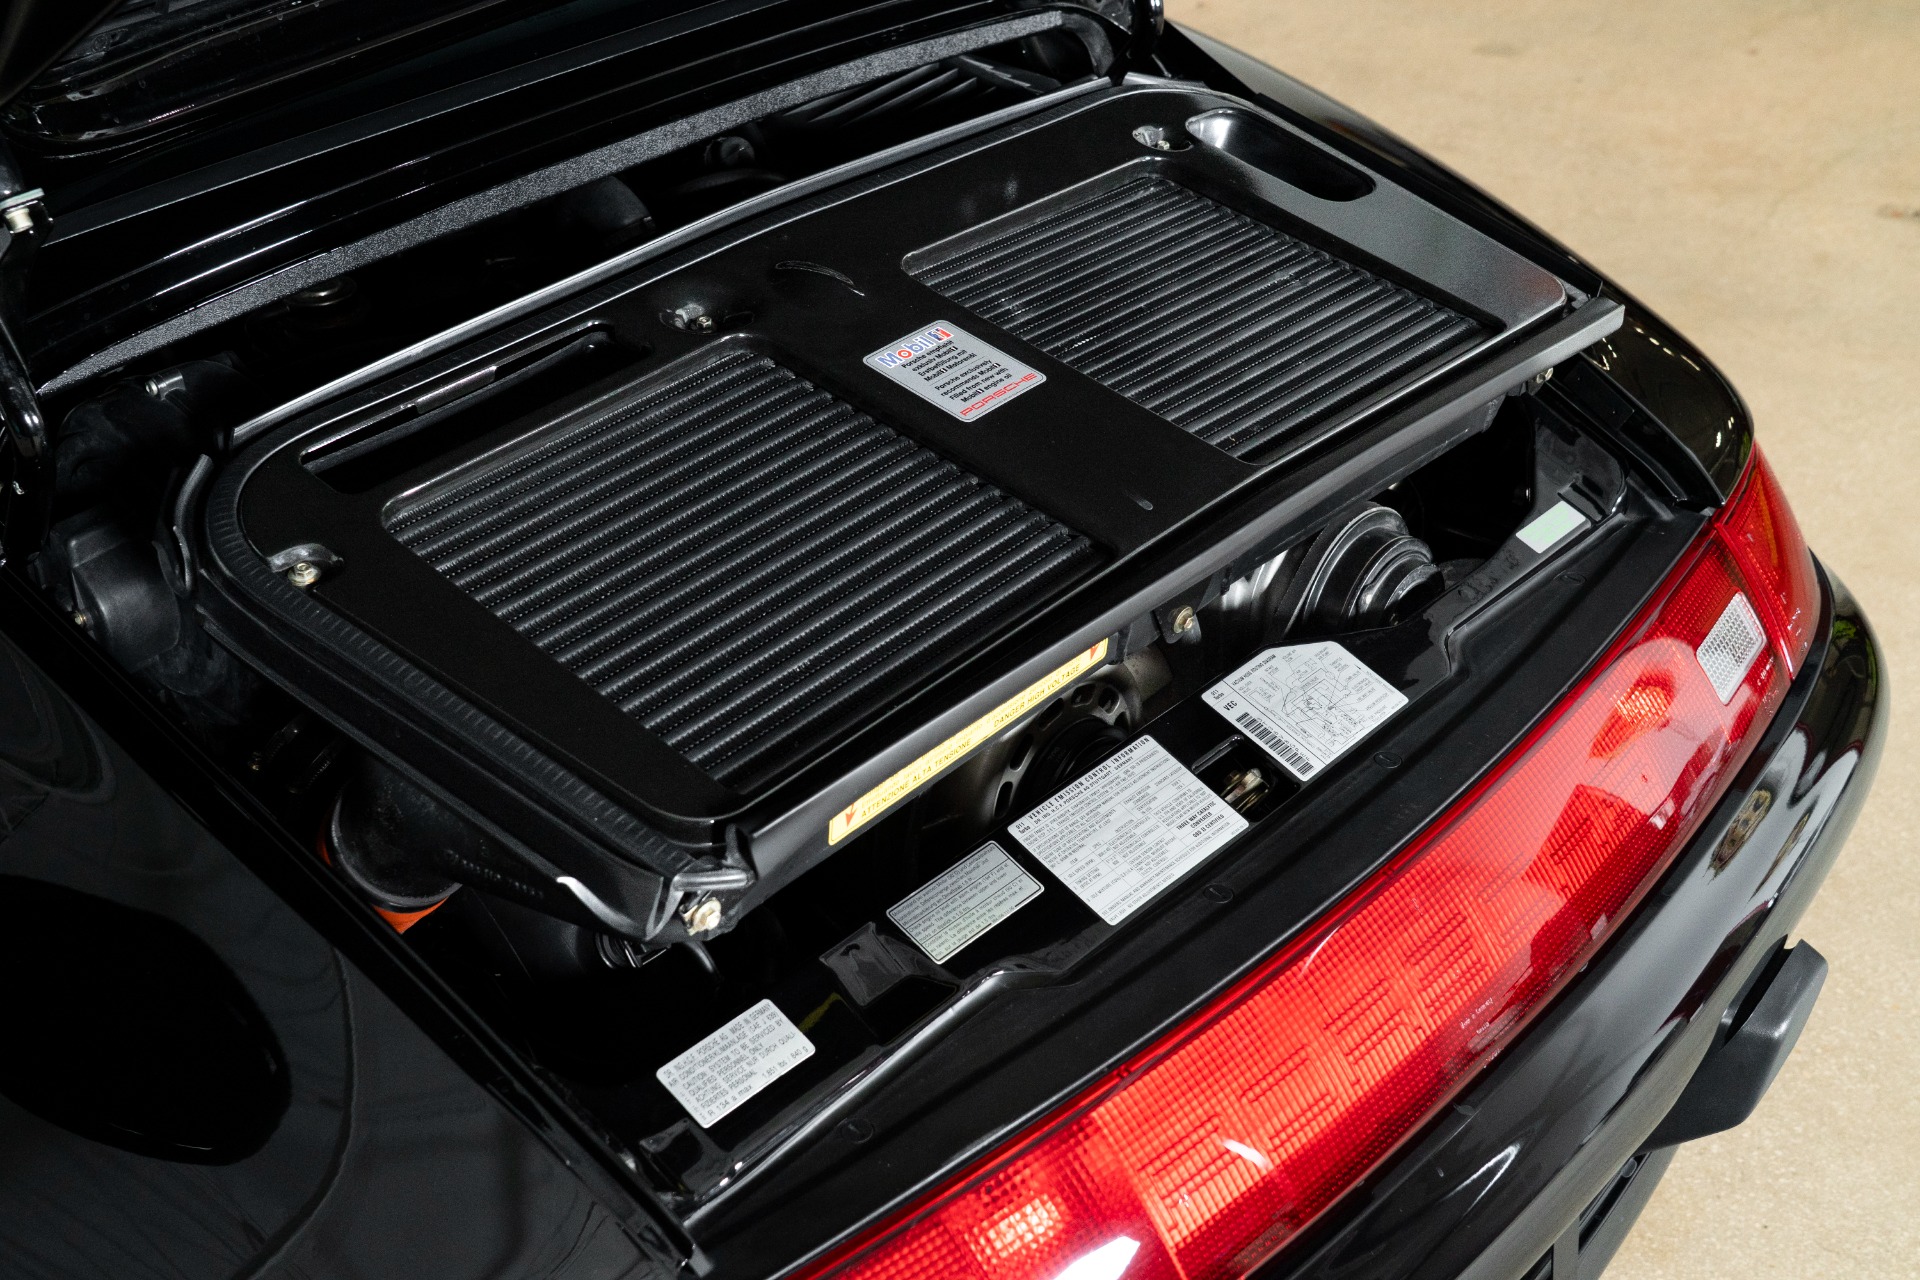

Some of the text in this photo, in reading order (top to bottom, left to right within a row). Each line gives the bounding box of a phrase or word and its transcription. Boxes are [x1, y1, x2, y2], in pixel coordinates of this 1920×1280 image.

[874, 333, 936, 369] Mobil
[900, 353, 928, 369] Porsche
[910, 356, 937, 372] exklusiv
[954, 348, 968, 357] mit
[933, 357, 993, 391] Porsche exclusively
[939, 373, 980, 397] recommends
[948, 366, 1009, 400] Filled from new with
[981, 376, 1006, 391] engine
[958, 371, 1038, 417] PORSCHE
[993, 661, 1081, 728] DANGER HIGH VOLTAGE
[1221, 698, 1238, 711] VEC
[861, 736, 971, 818] ATTENZIONE ALTA TENSIONE
[1026, 800, 1055, 820] VEHICLE
[1053, 780, 1085, 803] EMISSION
[1082, 762, 1112, 783] CONTROL
[1109, 736, 1150, 764] INFORMATION
[1062, 789, 1084, 805] PORSCHE
[1087, 769, 1113, 787] STUTTGART
[1112, 755, 1134, 771] GERMANY
[1014, 821, 1025, 830] 911
[1175, 799, 1217, 831] THREE WAY CATALYTIC
[1189, 810, 1213, 829] CONVERTER
[1203, 812, 1225, 829] CERTIFIED
[694, 1036, 721, 1057] PORSCHE
[707, 1053, 732, 1072] SYSTEM
[747, 1022, 776, 1045] SERVICED
